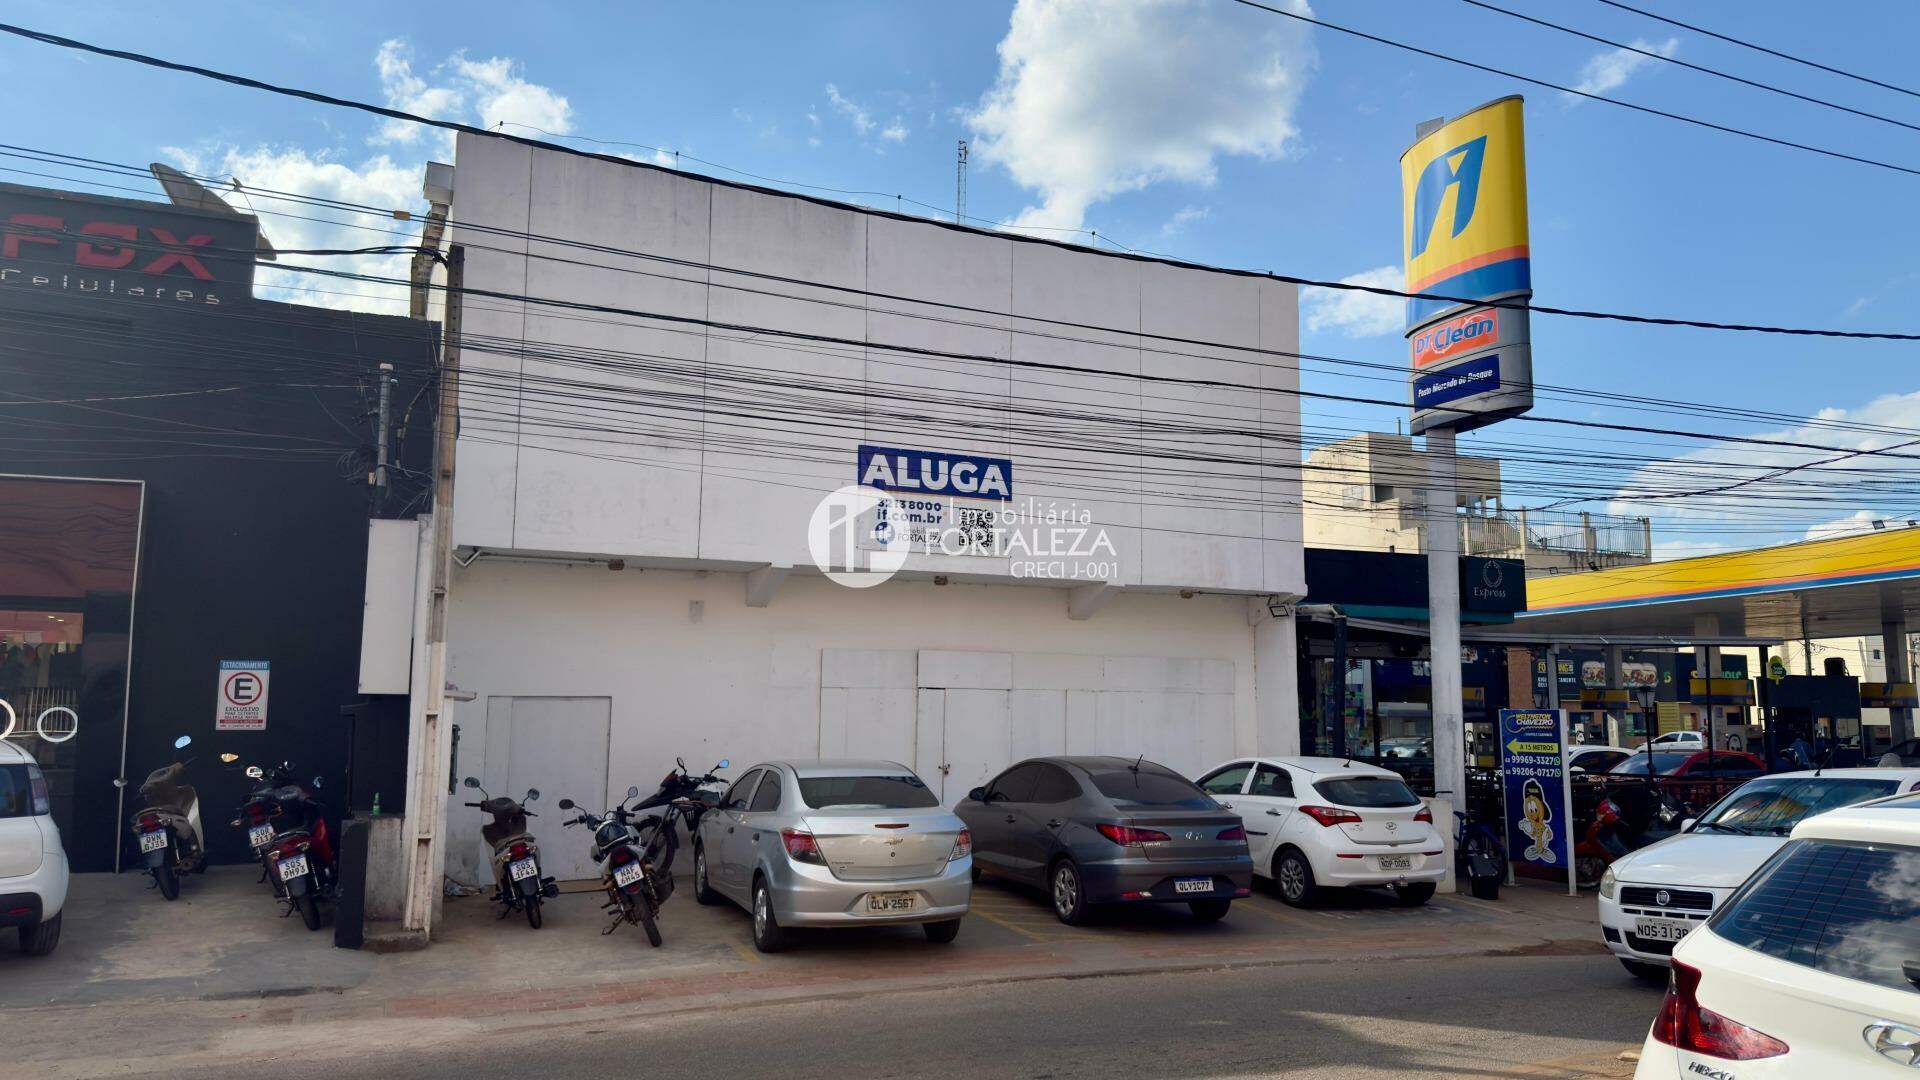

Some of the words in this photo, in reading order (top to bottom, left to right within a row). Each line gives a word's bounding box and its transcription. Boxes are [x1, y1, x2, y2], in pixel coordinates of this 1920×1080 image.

[2, 213, 217, 281] FOX
[1434, 318, 1494, 350] Clean
[1418, 387, 1432, 398] Posto
[1432, 377, 1458, 393] Mercado
[1458, 375, 1467, 385] do
[1467, 369, 1493, 383] Bosque
[861, 453, 1010, 497] ALUGA
[877, 508, 942, 524] if.com.br
[1473, 586, 1506, 600] Express
[222, 661, 268, 669] ESTACIONAMENTO
[234, 678, 253, 700] E
[1516, 718, 1554, 726] CHAVEIRO
[1511, 755, 1554, 765] 99969-3327
[1511, 766, 1555, 777] 99206-0717
